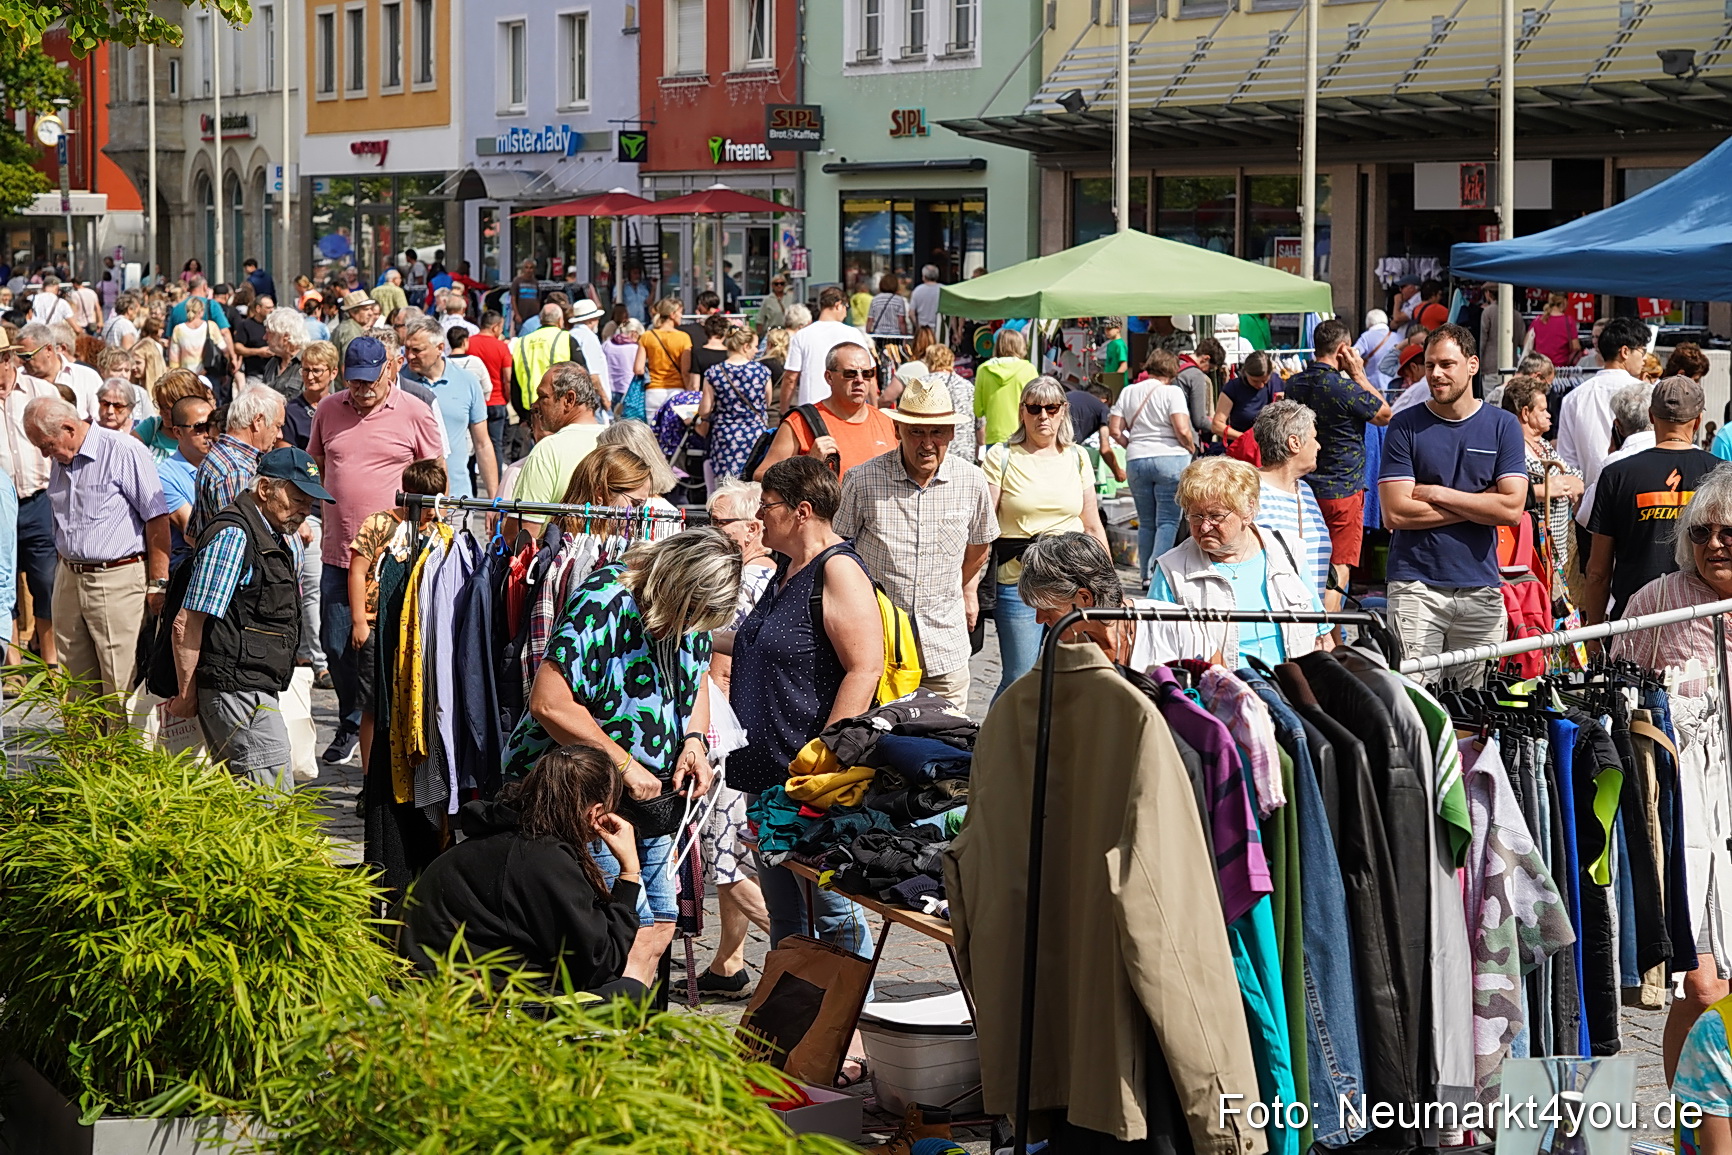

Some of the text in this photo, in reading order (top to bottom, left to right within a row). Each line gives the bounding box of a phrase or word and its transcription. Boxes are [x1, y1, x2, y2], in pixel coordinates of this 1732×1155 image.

[771, 109, 820, 128] SIPL
[889, 107, 929, 137] SIPL
[725, 139, 772, 162] freenet
[1278, 244, 1302, 258] SALE
[1638, 507, 1684, 522] SPECIA
